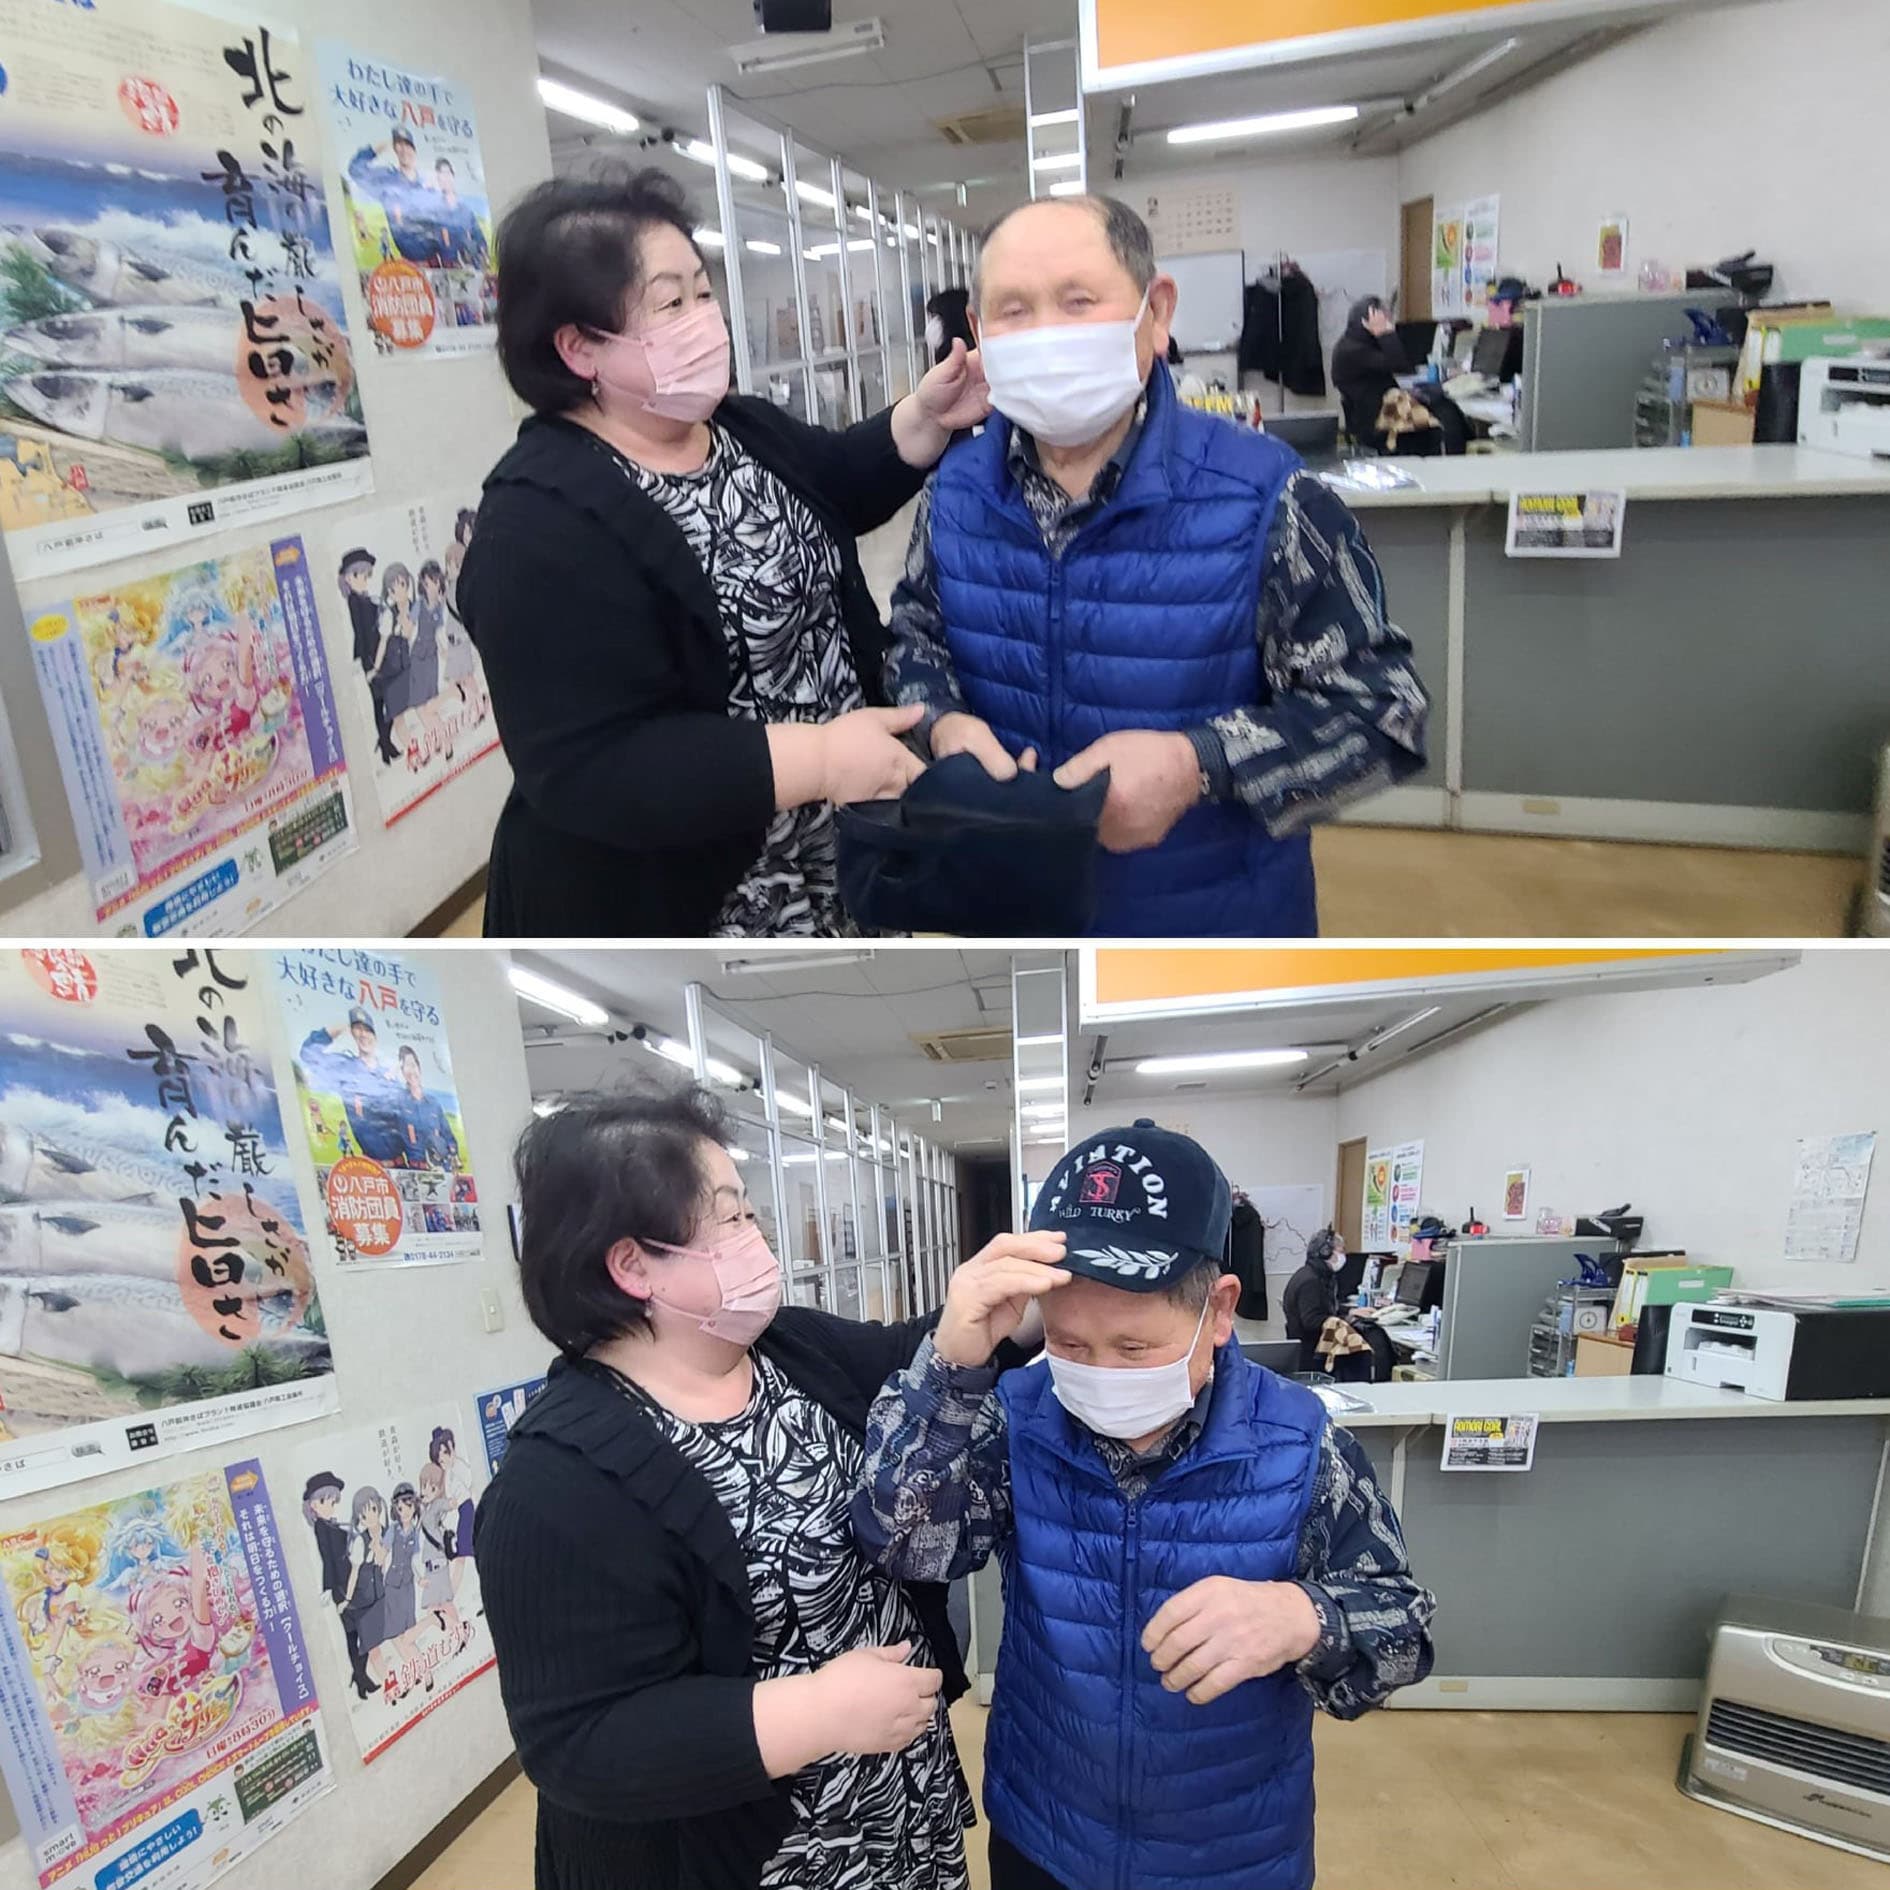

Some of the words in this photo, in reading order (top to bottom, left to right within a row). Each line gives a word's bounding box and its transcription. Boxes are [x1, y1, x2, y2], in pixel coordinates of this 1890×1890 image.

[276, 955, 440, 1026] 大好きな八戸を守る
[349, 1177, 390, 1195] 八戸市
[331, 1195, 401, 1220] 消防団員
[353, 1222, 391, 1246] 募集
